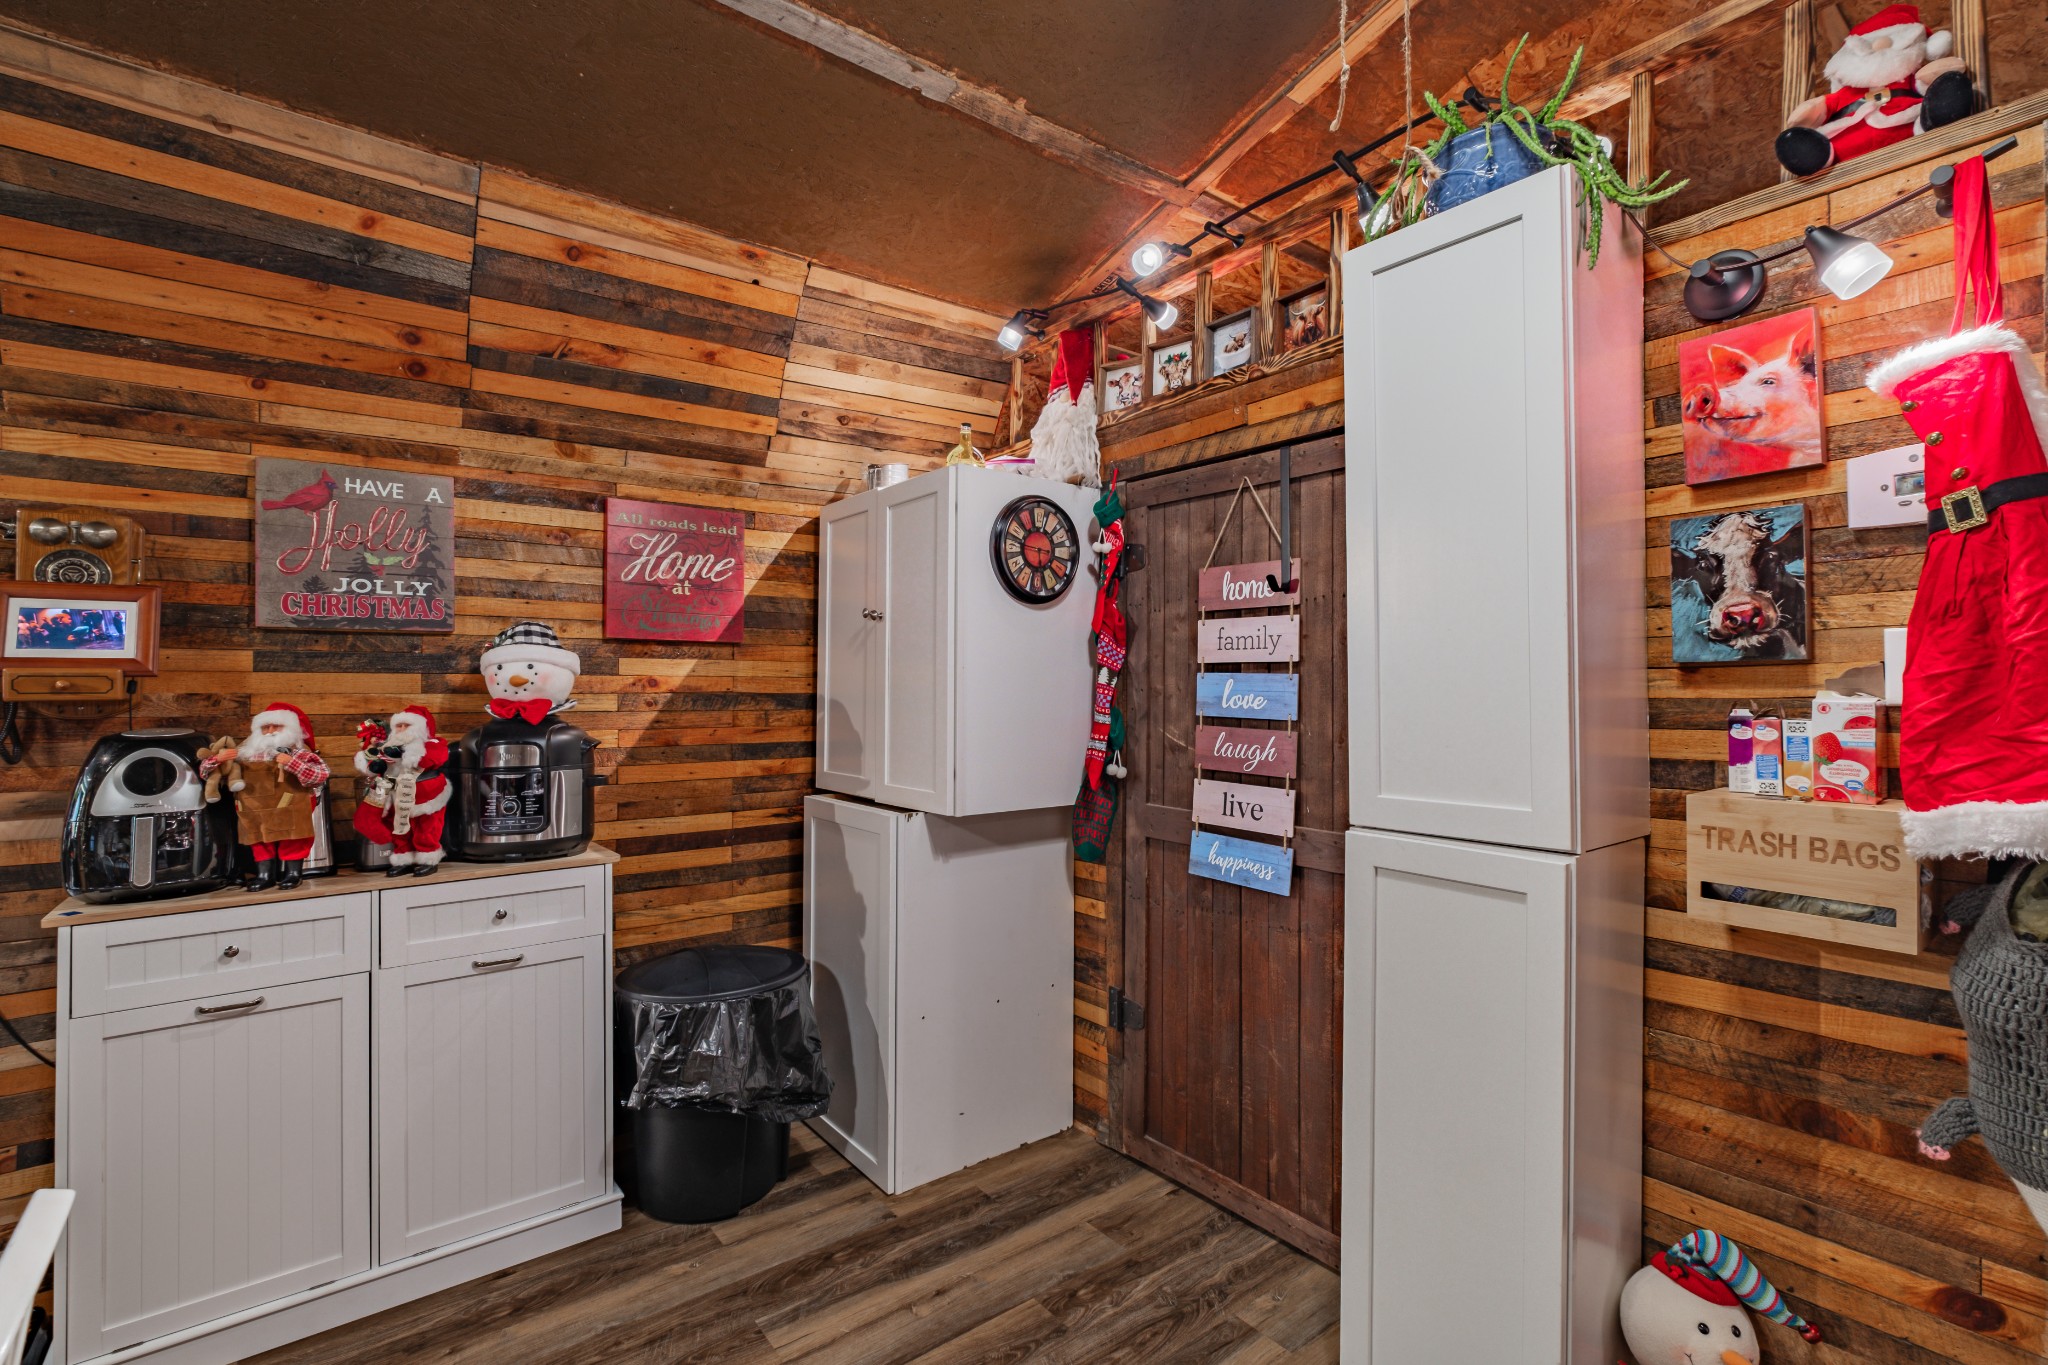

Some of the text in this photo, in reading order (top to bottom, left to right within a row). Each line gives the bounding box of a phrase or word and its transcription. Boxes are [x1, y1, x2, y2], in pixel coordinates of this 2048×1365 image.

[344, 477, 444, 504] HAVE A
[276, 499, 430, 576] Holly
[615, 512, 738, 536] All roads lead
[621, 531, 736, 582] Home
[332, 577, 433, 596] JOLLY
[672, 580, 692, 596] at
[1222, 571, 1276, 601] home
[281, 592, 445, 620] CHRISTMAS
[1217, 625, 1282, 655] family
[1221, 678, 1267, 709] love
[1213, 731, 1277, 772] laugh
[1221, 792, 1264, 821] live
[1208, 841, 1275, 881] happiness
[1701, 825, 1900, 872] TRASH BAGS
